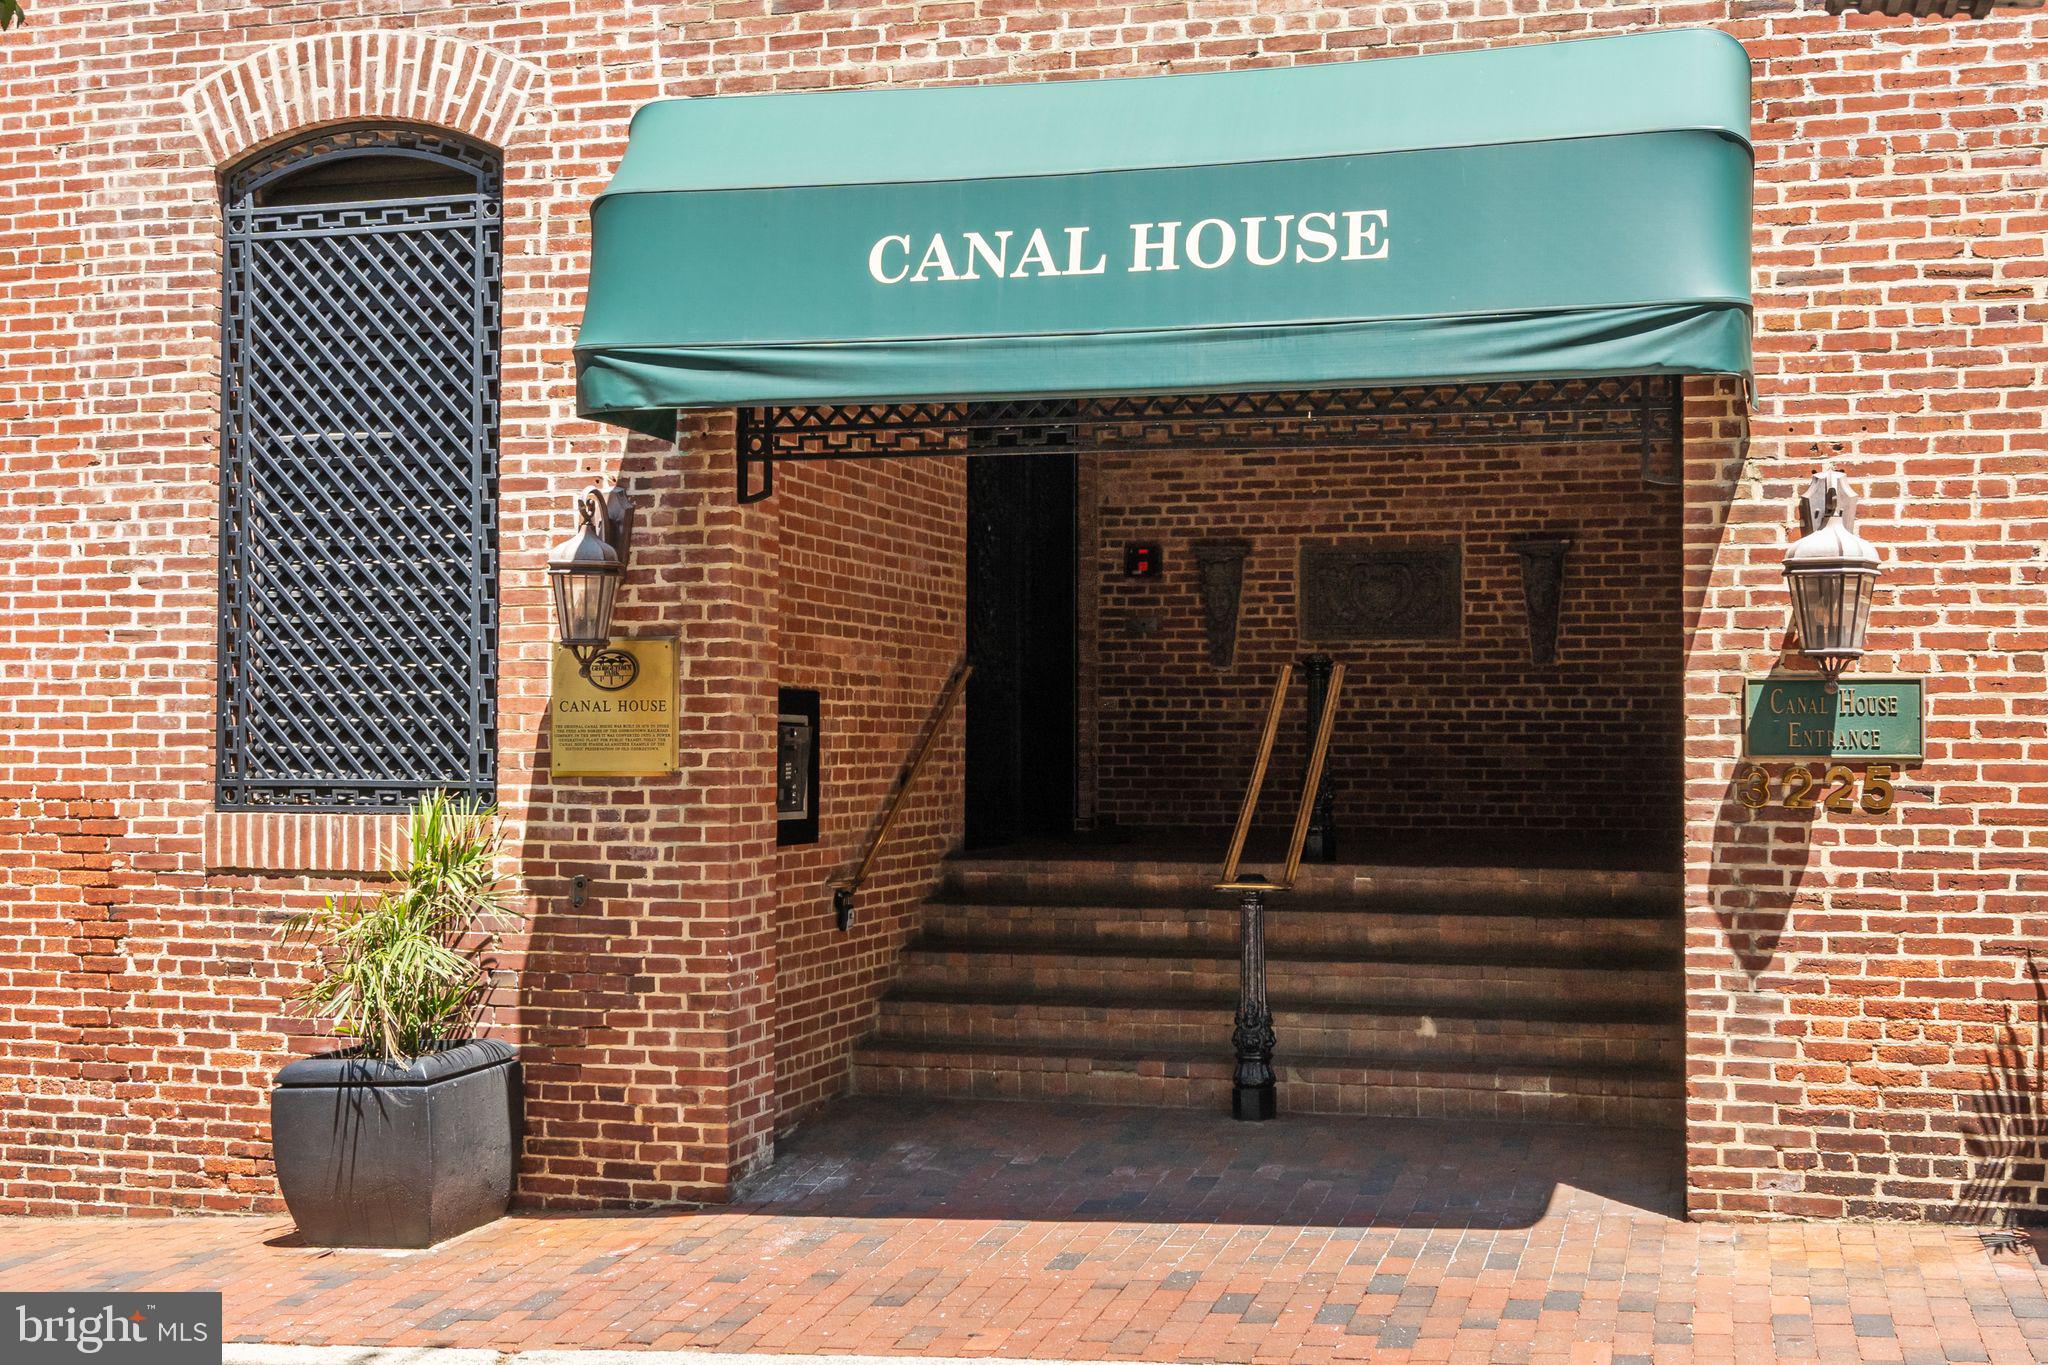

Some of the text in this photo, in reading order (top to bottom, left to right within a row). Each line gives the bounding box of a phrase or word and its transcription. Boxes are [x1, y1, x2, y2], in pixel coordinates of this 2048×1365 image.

[868, 209, 1390, 284] CANAL HOUSE
[559, 700, 667, 713] CANAL HOUSE
[1738, 765, 1894, 811] 3225
